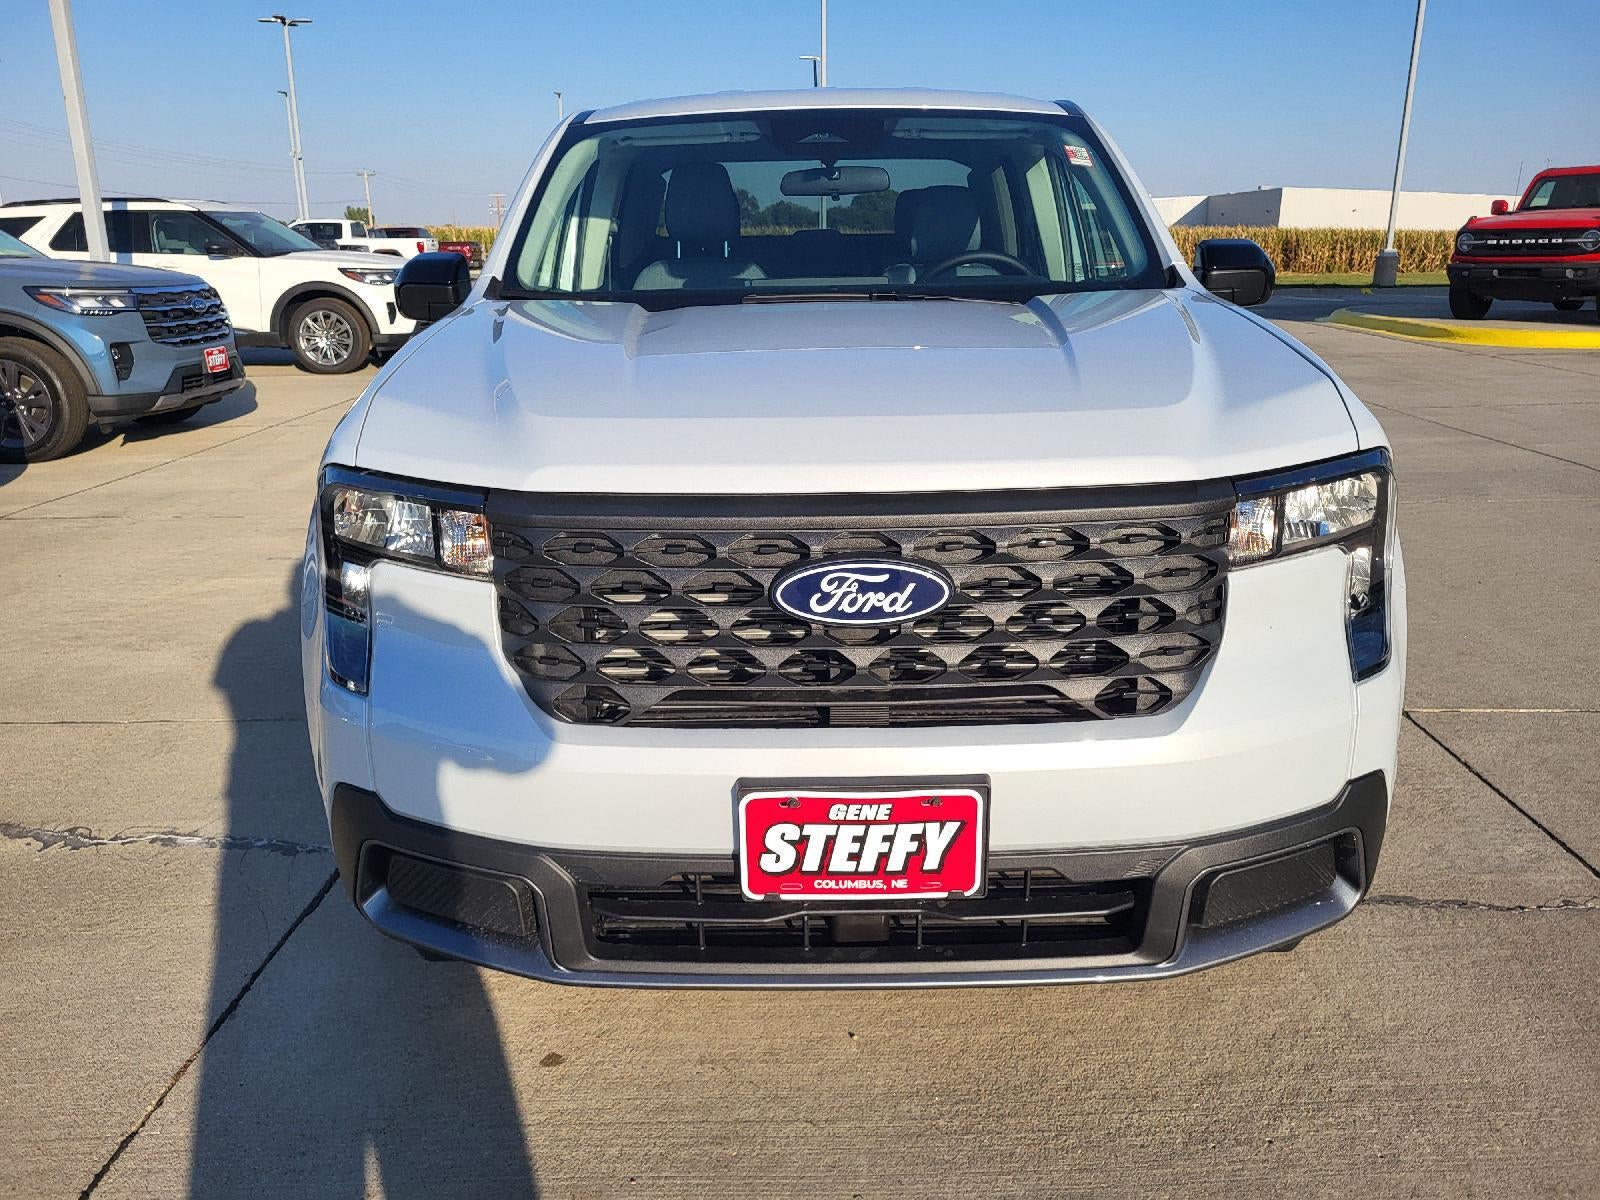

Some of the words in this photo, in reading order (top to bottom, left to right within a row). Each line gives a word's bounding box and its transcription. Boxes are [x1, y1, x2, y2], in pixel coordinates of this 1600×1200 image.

[809, 572, 916, 613] Ford
[828, 803, 893, 821] GENE
[759, 821, 964, 874] STEFFY
[813, 879, 887, 890] COLUMBUS,
[891, 879, 909, 889] NE
